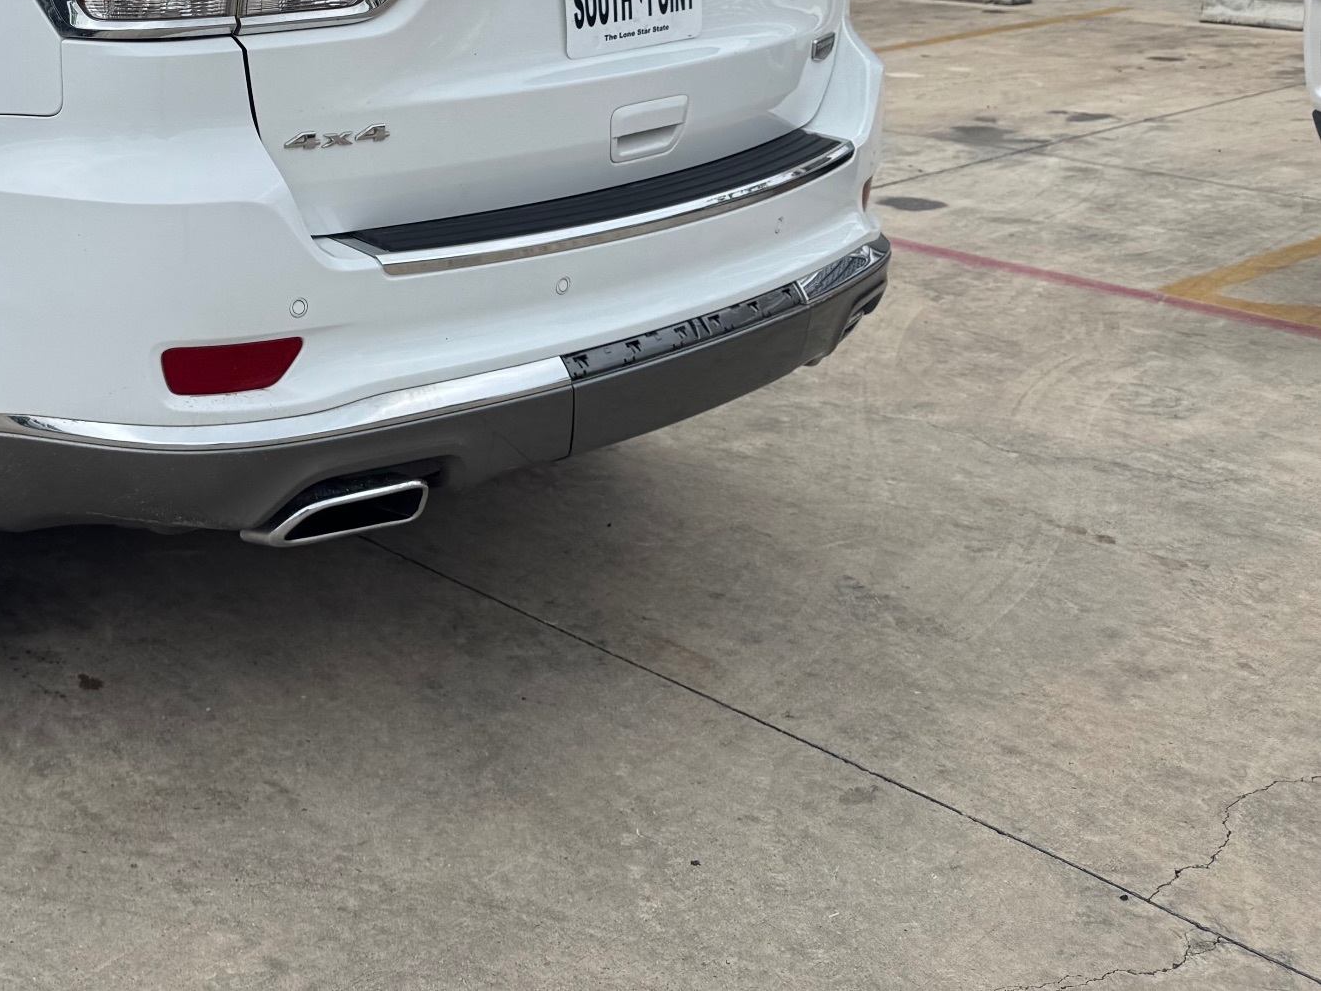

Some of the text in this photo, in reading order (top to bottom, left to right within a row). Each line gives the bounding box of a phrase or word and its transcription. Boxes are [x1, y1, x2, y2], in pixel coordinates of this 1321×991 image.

[604, 24, 670, 42] The Lone Star State
